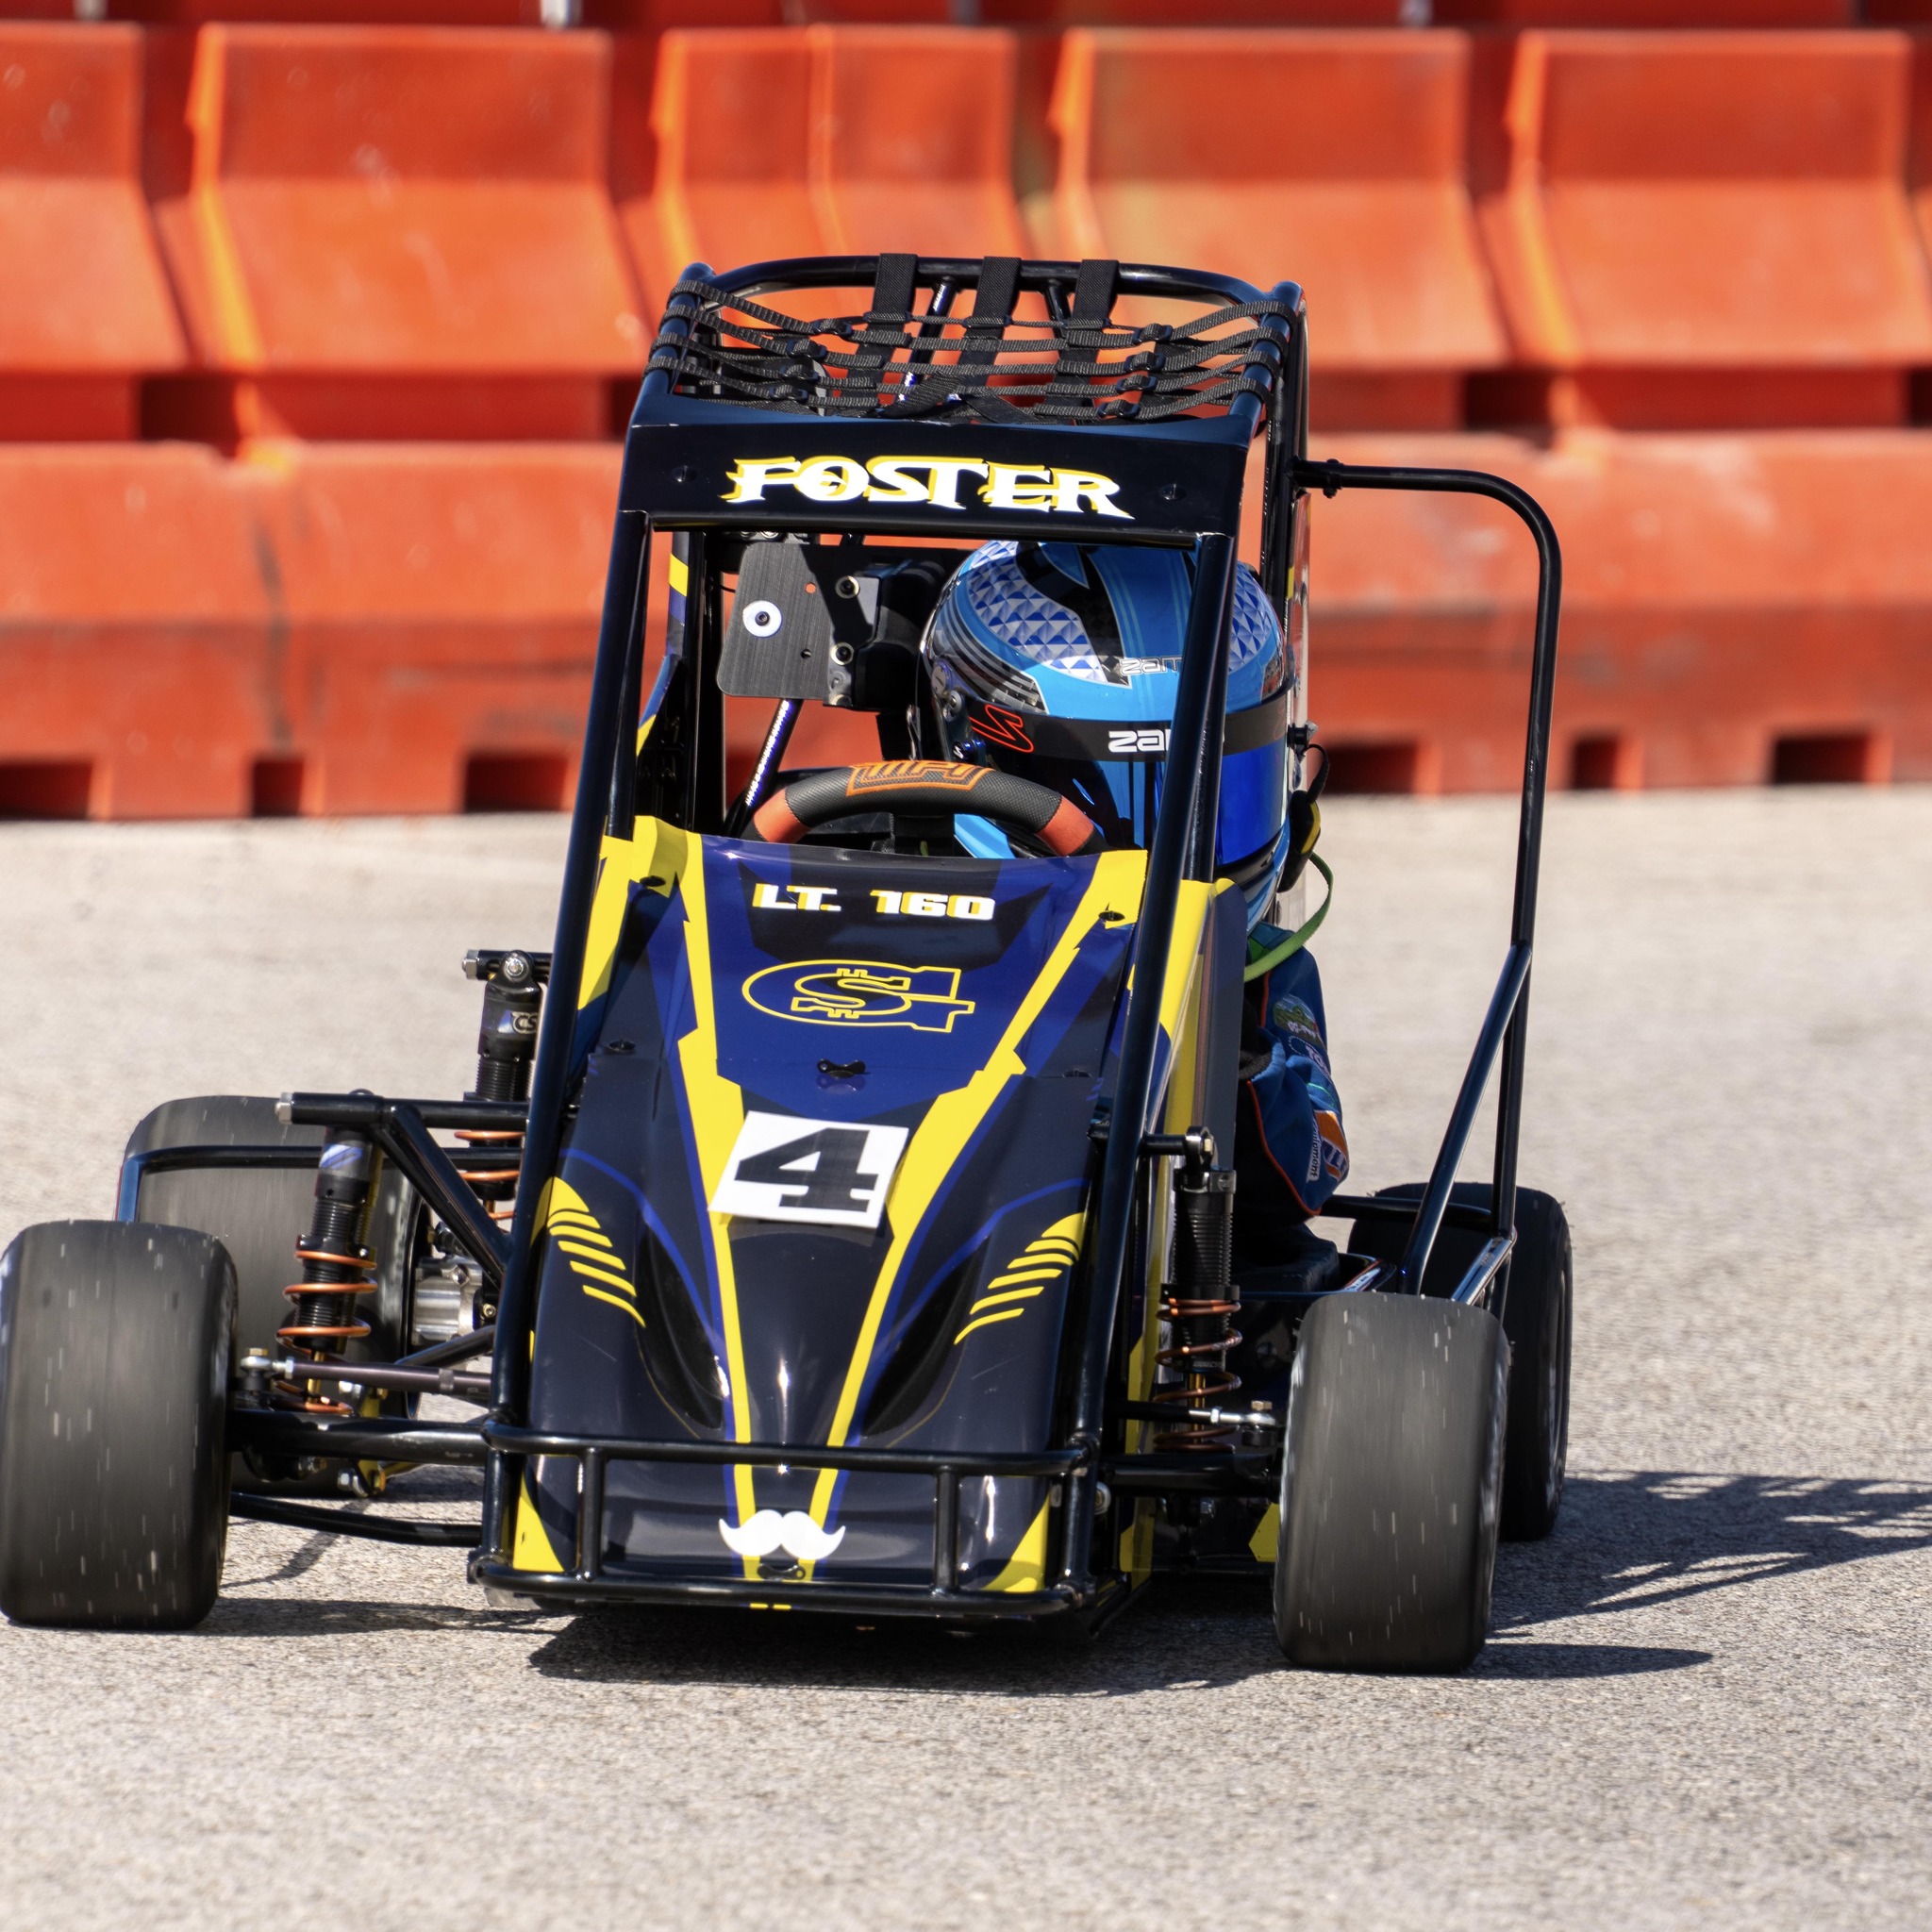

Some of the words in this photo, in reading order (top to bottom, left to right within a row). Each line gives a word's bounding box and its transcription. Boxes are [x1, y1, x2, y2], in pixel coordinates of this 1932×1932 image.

[721, 455, 1135, 520] FOSTER
[1120, 656, 1182, 676] zam
[1108, 728, 1171, 753] za
[753, 883, 841, 912] LT.
[870, 890, 996, 921] 160
[734, 1127, 879, 1213] 4
